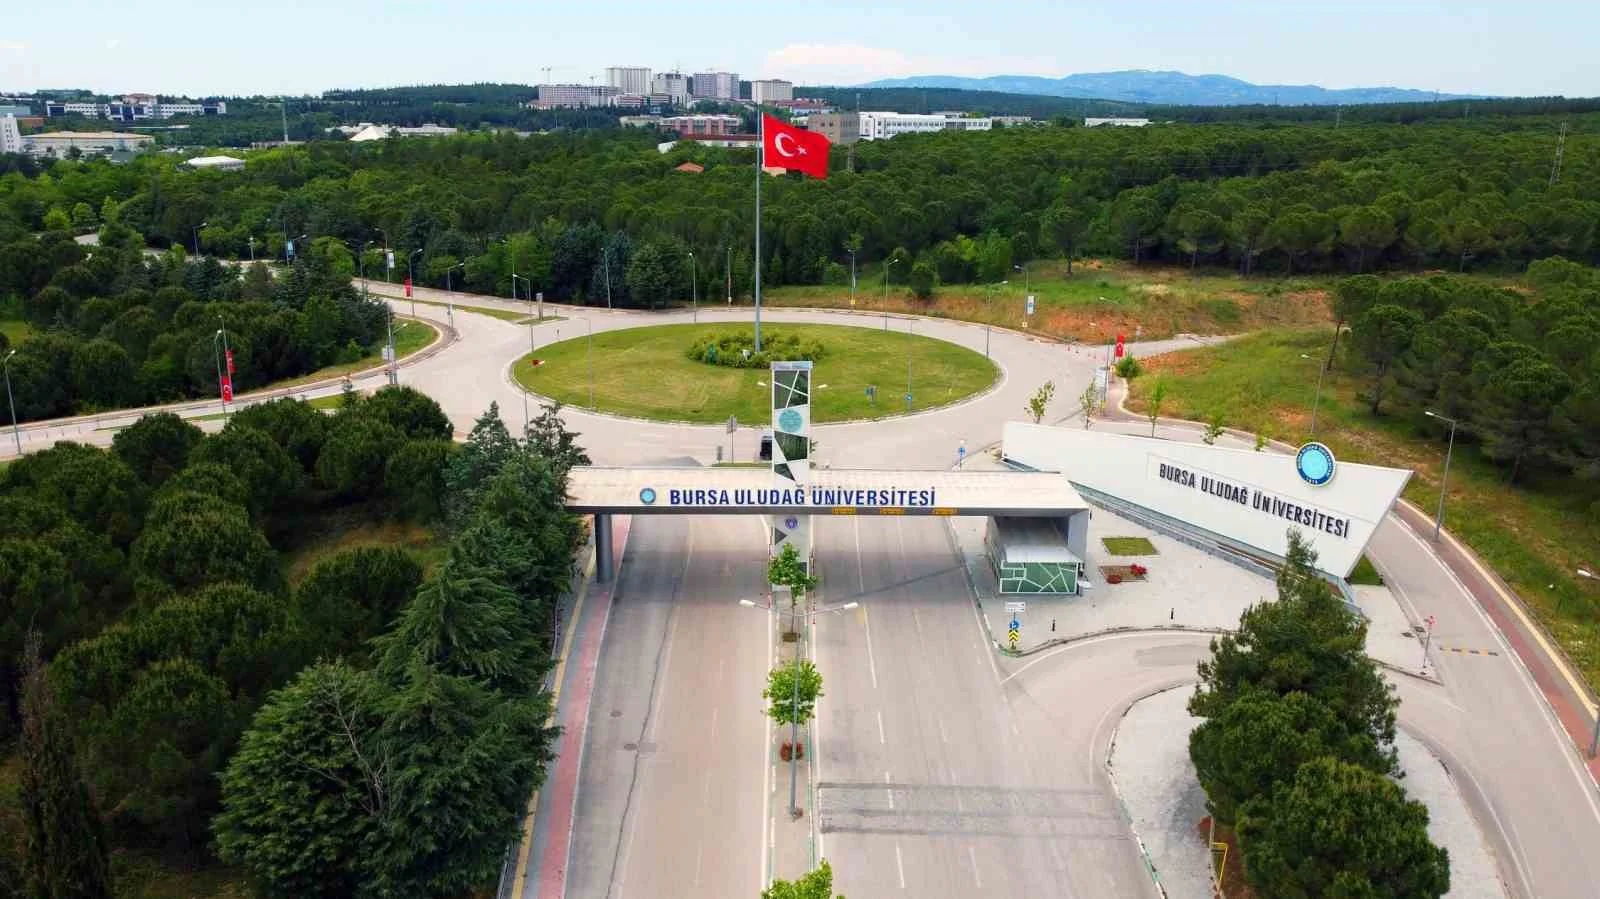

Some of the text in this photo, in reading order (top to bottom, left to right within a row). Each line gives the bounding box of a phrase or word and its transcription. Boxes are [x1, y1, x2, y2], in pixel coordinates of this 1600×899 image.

[670, 484, 936, 506] BURSA ULUDAĞ ÜNİVERSİTESİ
[1159, 463, 1351, 538] BURSA ULUDAĞ ÜNİVERSİTESİ
